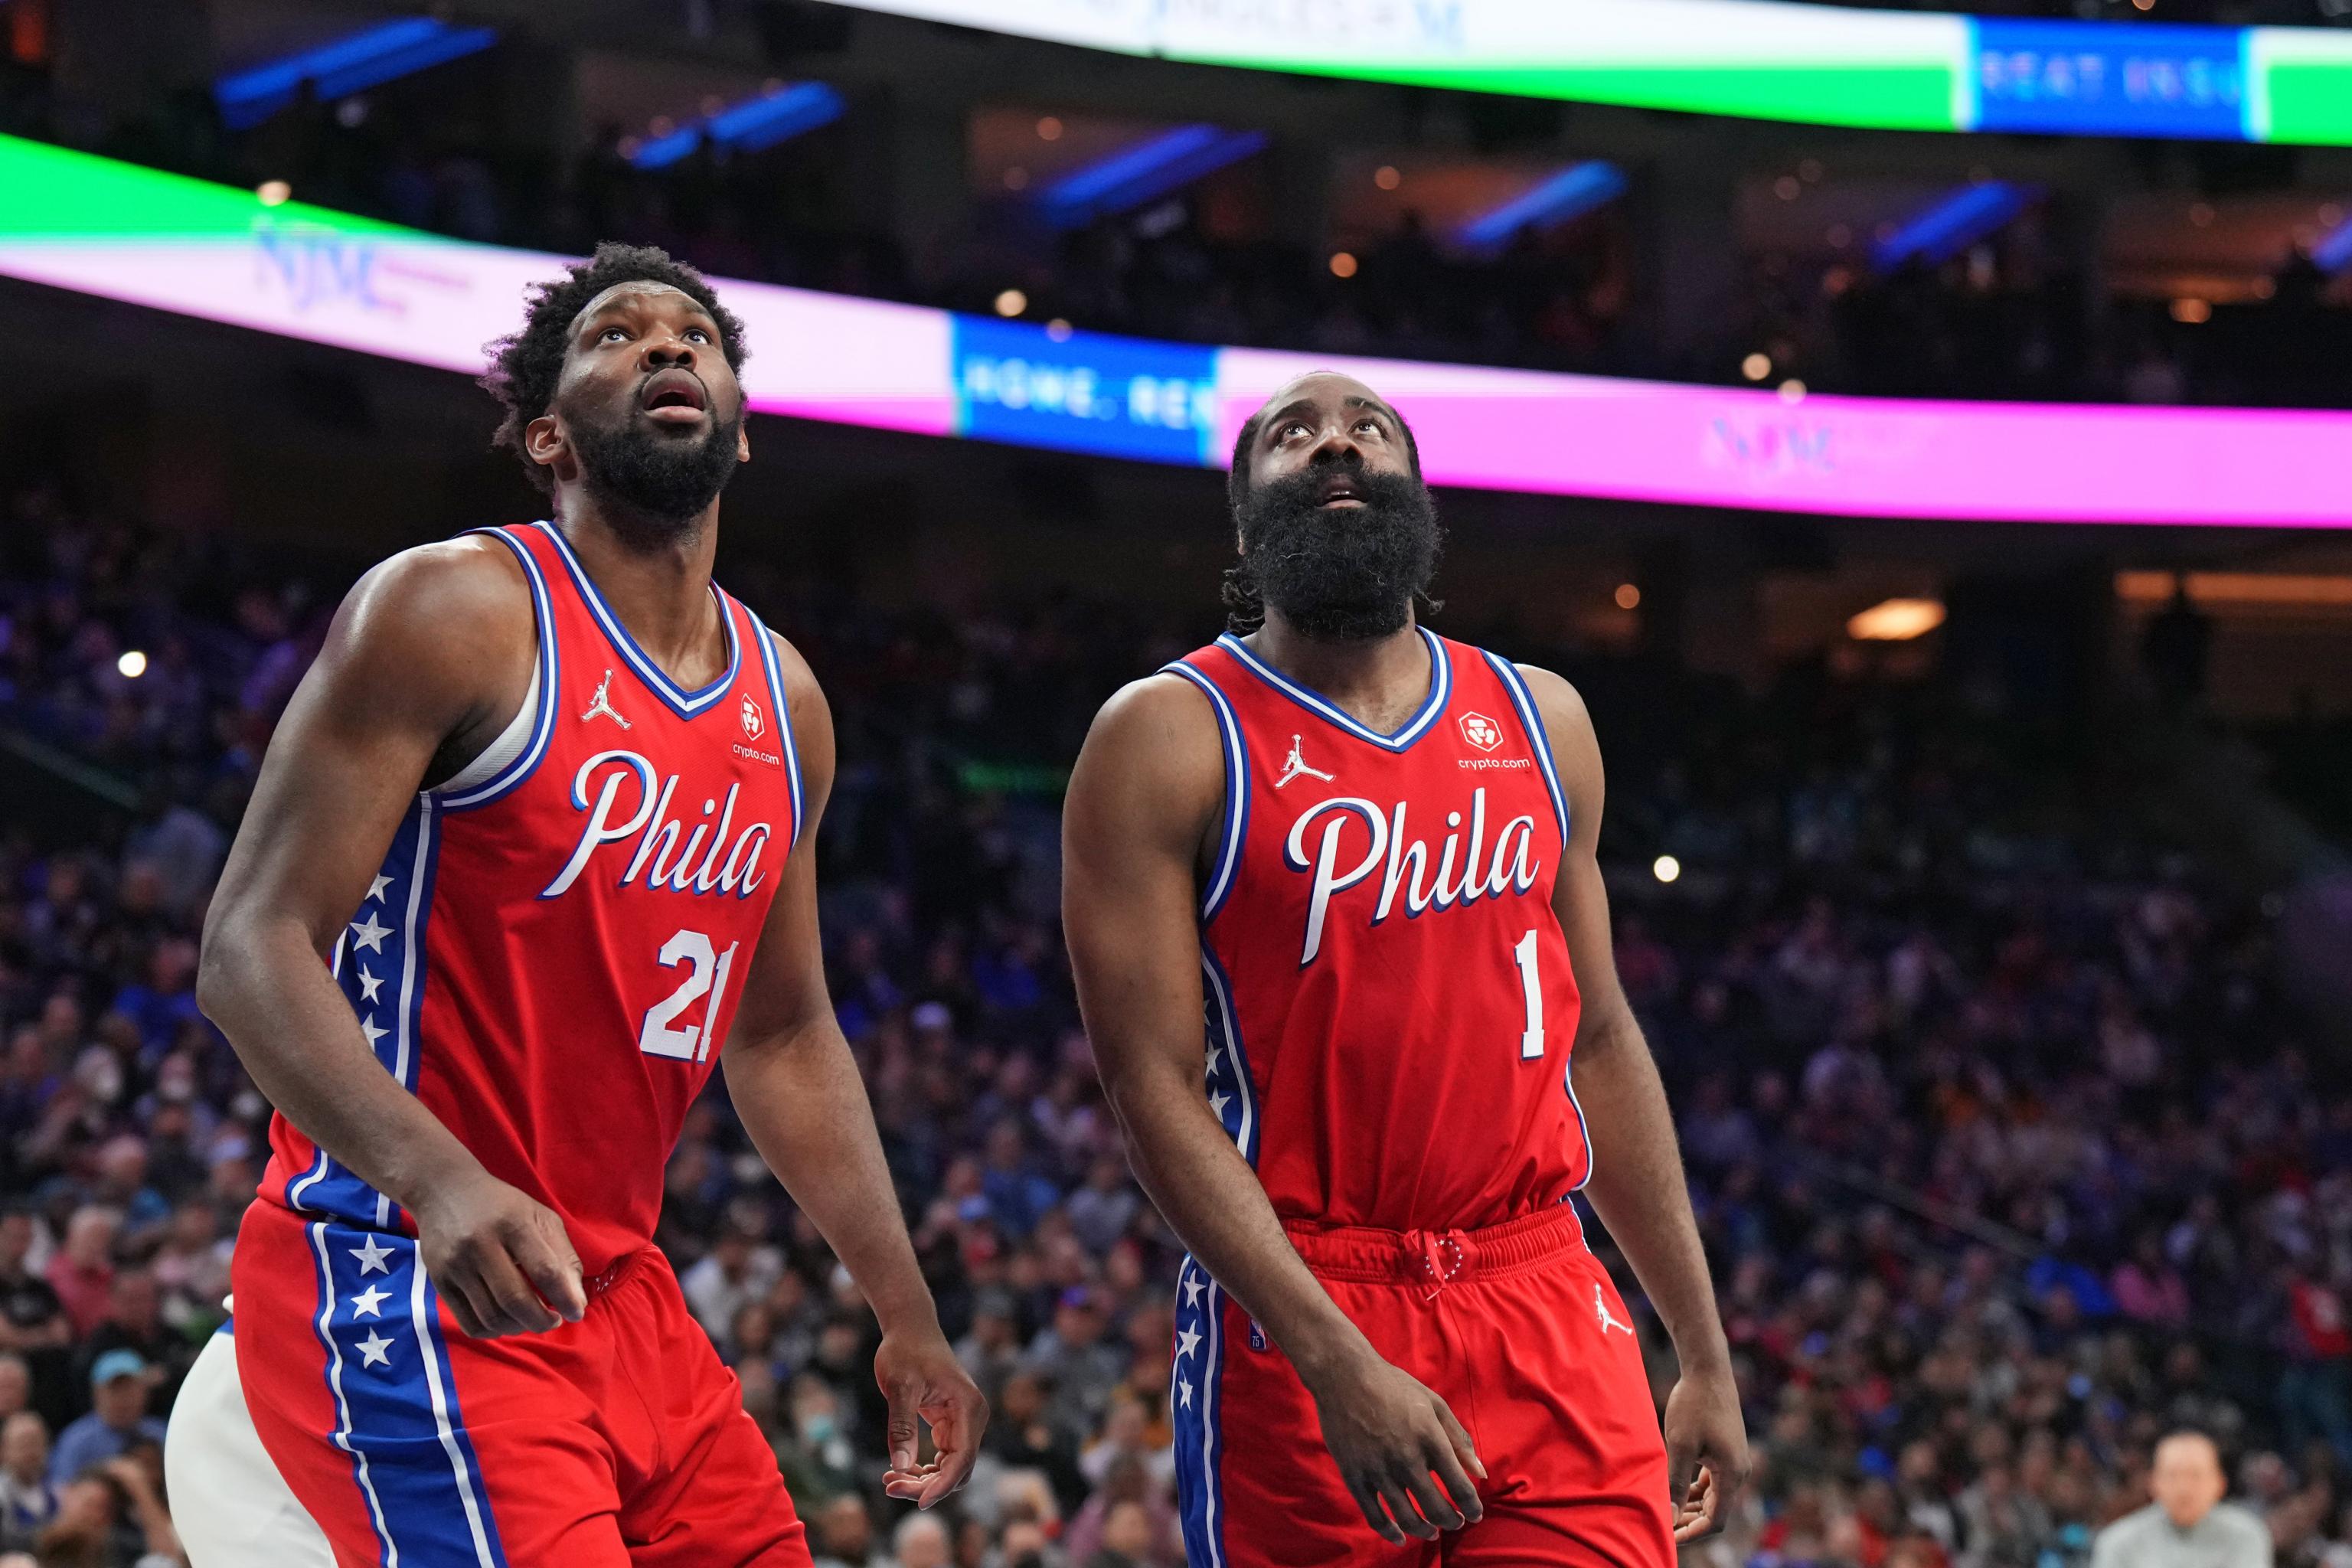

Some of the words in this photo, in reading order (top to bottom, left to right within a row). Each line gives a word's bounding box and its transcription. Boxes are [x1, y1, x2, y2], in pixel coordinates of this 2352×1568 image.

[733, 743, 779, 766] crypto.com
[1458, 758, 1530, 770] crypto.com
[535, 750, 771, 900] Phila
[1283, 787, 1540, 971] Phila
[639, 929, 740, 1065] 21
[1514, 929, 1545, 1060] 1
[1252, 1335, 1260, 1348] 75
